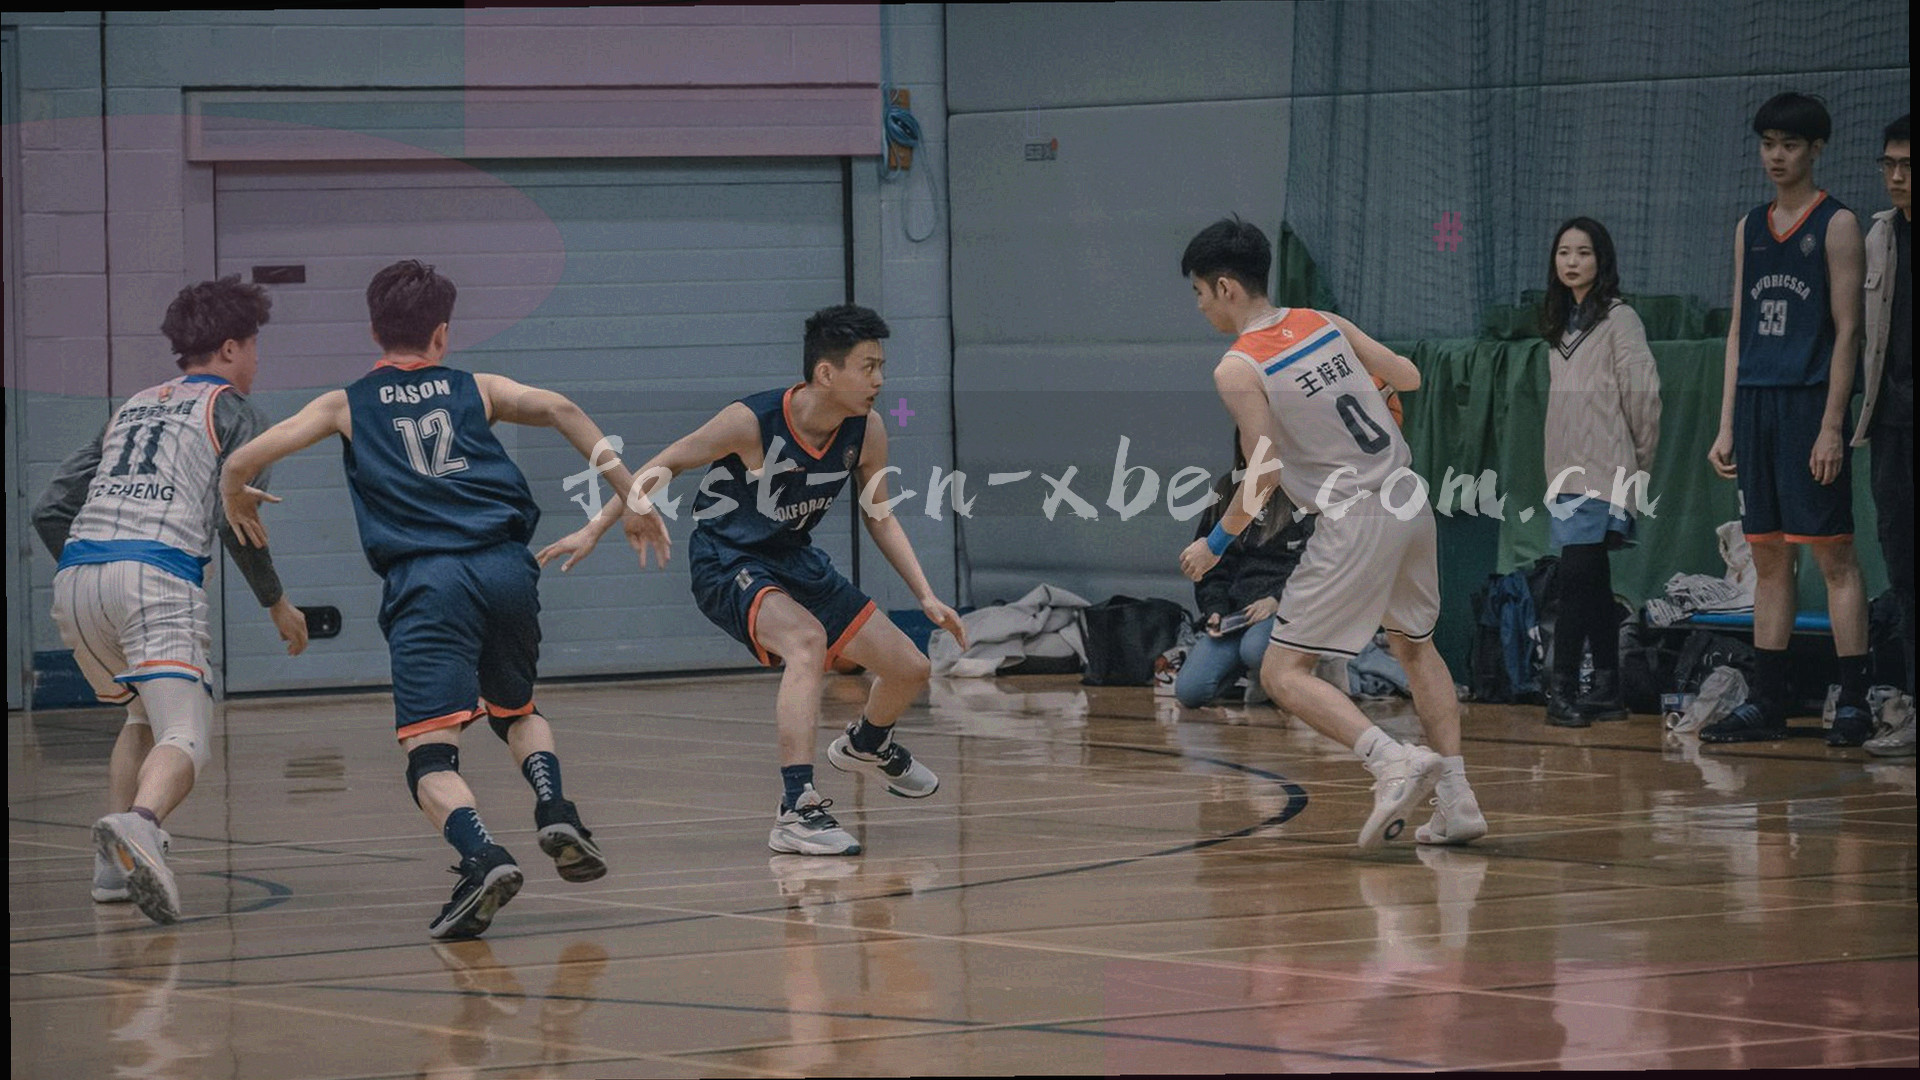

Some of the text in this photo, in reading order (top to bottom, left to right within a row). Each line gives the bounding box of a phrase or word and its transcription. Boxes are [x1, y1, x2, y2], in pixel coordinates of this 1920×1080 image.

[1758, 299, 1788, 336] 33
[379, 380, 451, 404] CASON
[110, 420, 166, 477] 11
[393, 408, 470, 478] 12
[1336, 394, 1391, 455] 0
